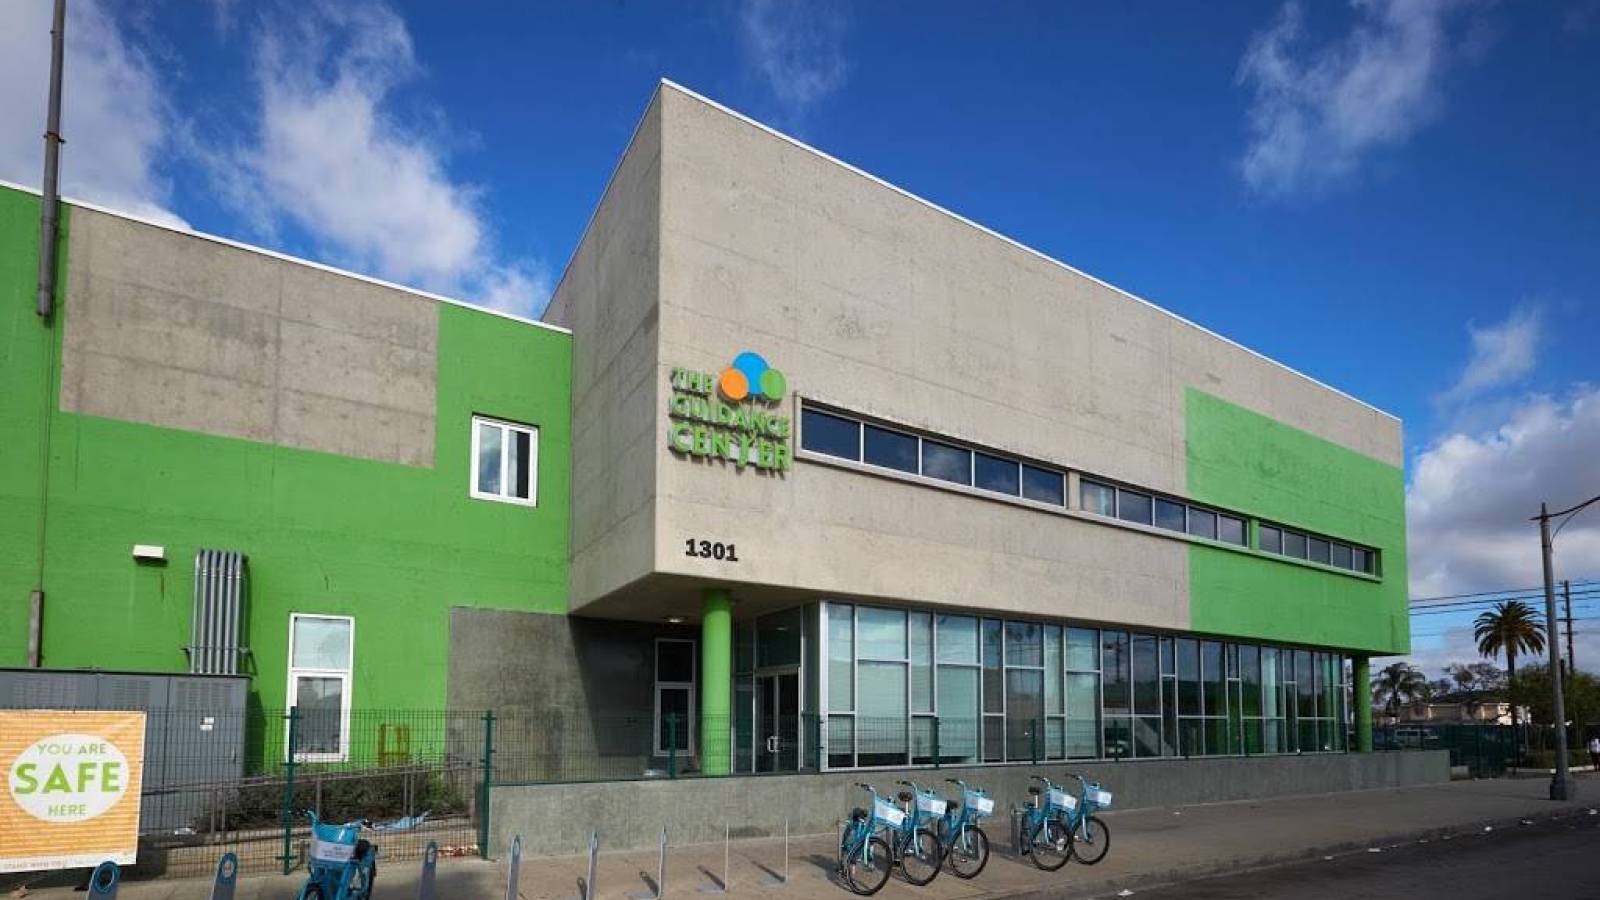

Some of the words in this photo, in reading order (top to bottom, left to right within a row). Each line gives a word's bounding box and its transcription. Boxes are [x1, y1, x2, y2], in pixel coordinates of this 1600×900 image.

[670, 367, 713, 394] THE
[669, 393, 791, 437] GUIDANCE
[669, 421, 791, 471] CENTER
[685, 539, 738, 562] 1301
[37, 743, 73, 755] YOU
[78, 743, 107, 755] ARE
[14, 762, 121, 795] SAFE
[48, 804, 87, 817] HERE
